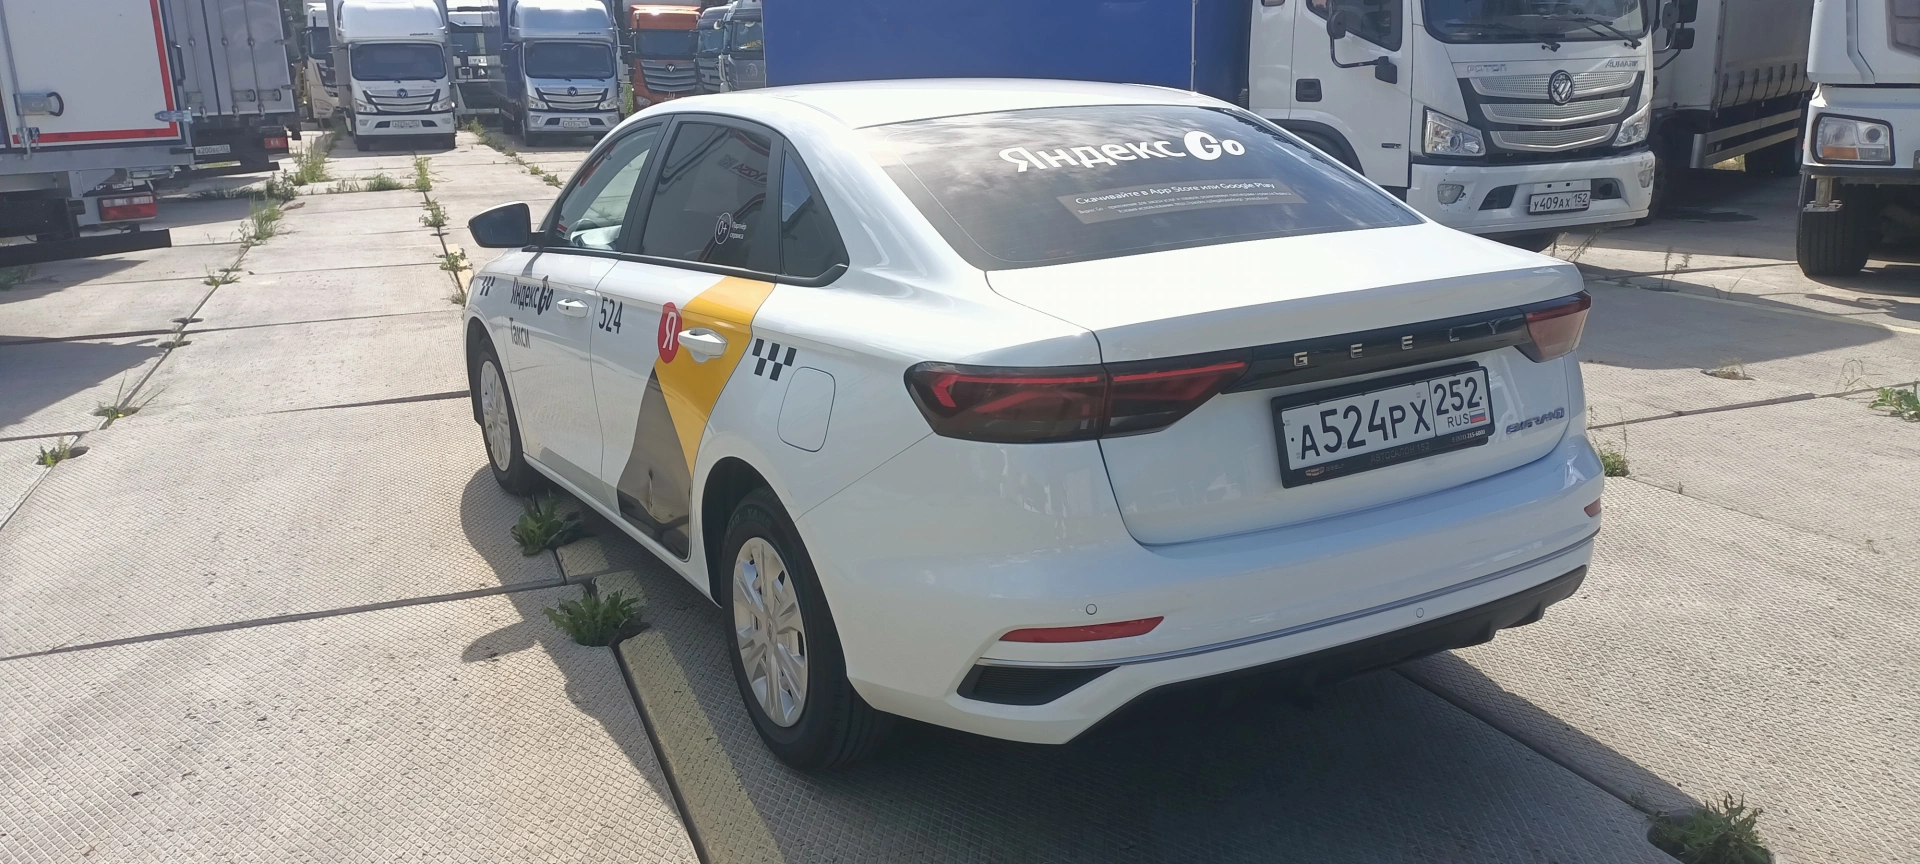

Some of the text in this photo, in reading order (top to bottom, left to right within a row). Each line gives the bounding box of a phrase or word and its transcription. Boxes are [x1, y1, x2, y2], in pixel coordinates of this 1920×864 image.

[1605, 59, 1639, 68] AUMARK
[998, 131, 1246, 173] Яндекс Go
[1075, 191, 1140, 205] Скачивайте
[1220, 182, 1255, 190] Google
[1533, 193, 1588, 211] У409АХ 152
[717, 220, 727, 235] 0+
[510, 275, 553, 315] Яндекс Go
[598, 296, 623, 334] 524
[662, 311, 677, 351] Я
[508, 317, 531, 349] Такси
[1293, 320, 1500, 367] GEELY
[1300, 376, 1480, 460] А524РХ 252
[1447, 413, 1469, 428] RUS
[1370, 442, 1430, 463] АВТОСАЛОН 152
